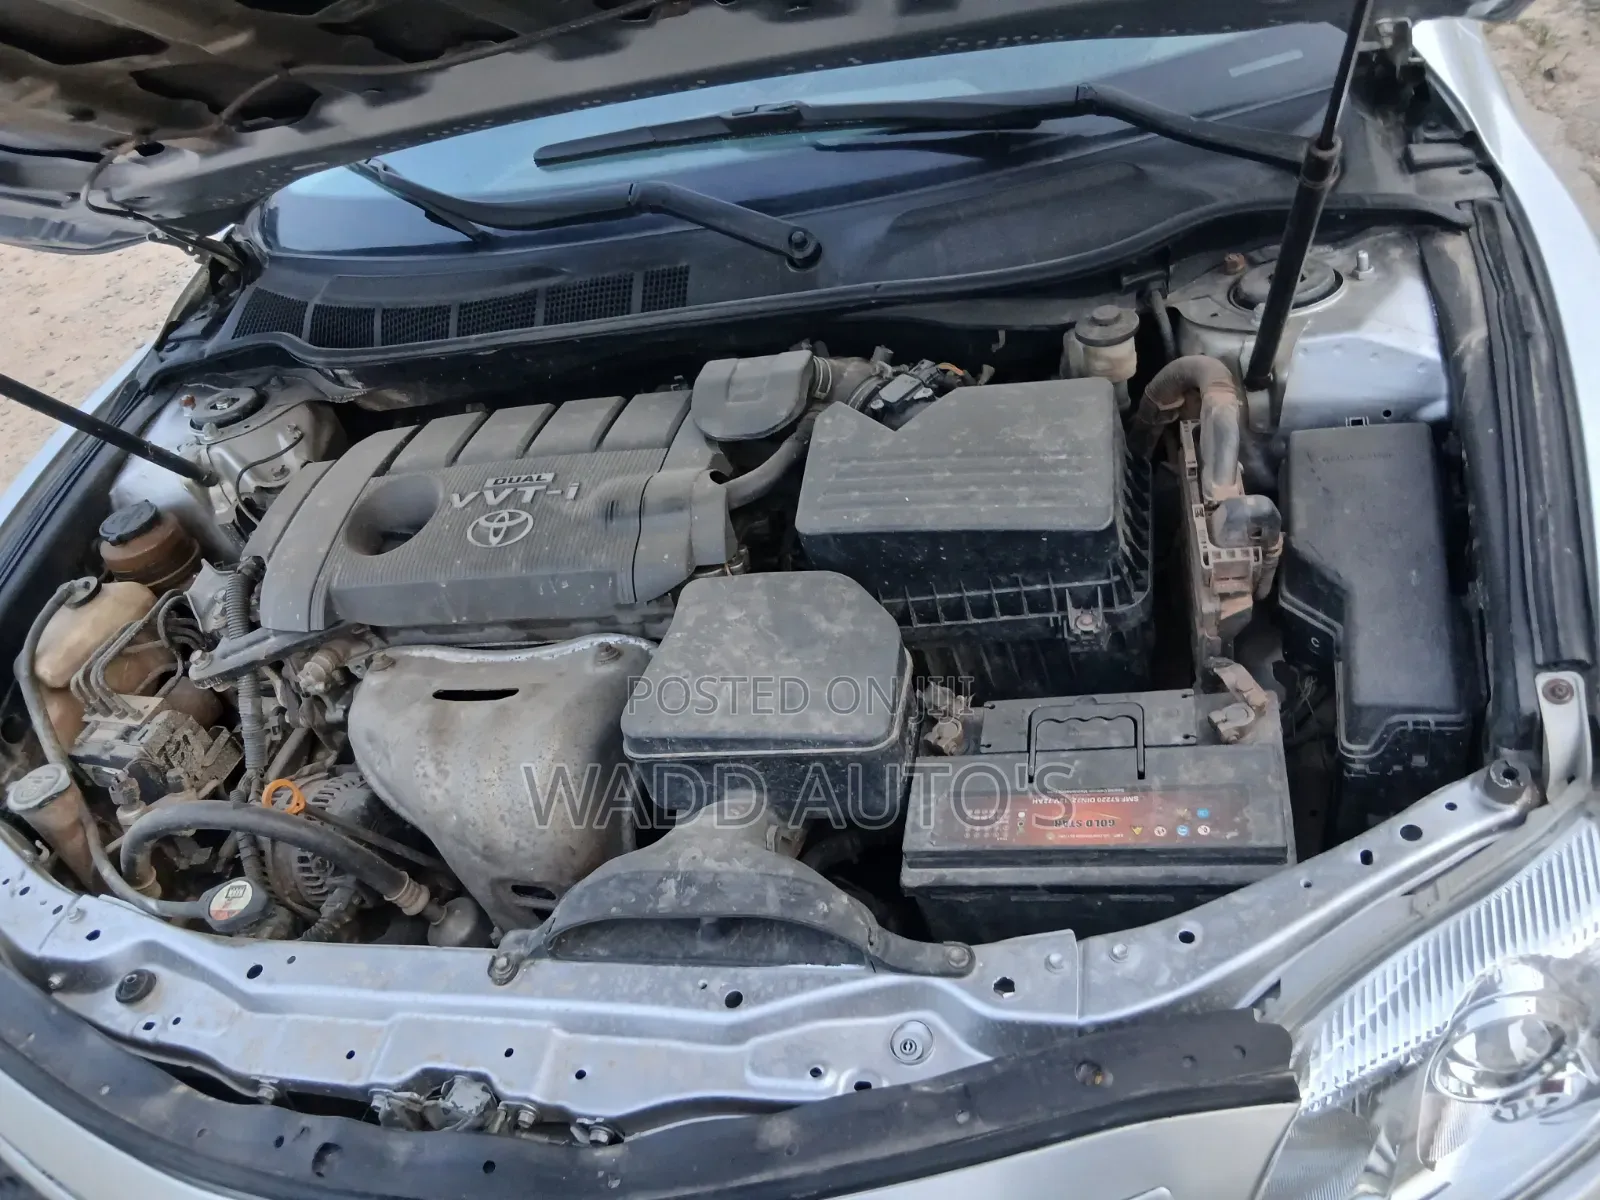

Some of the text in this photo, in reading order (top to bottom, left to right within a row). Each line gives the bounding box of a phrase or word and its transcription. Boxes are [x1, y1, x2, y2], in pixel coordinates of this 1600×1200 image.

[493, 475, 547, 485] DUAL
[1122, 795, 1139, 803] SMF
[1054, 819, 1115, 829] GOLD STAR
